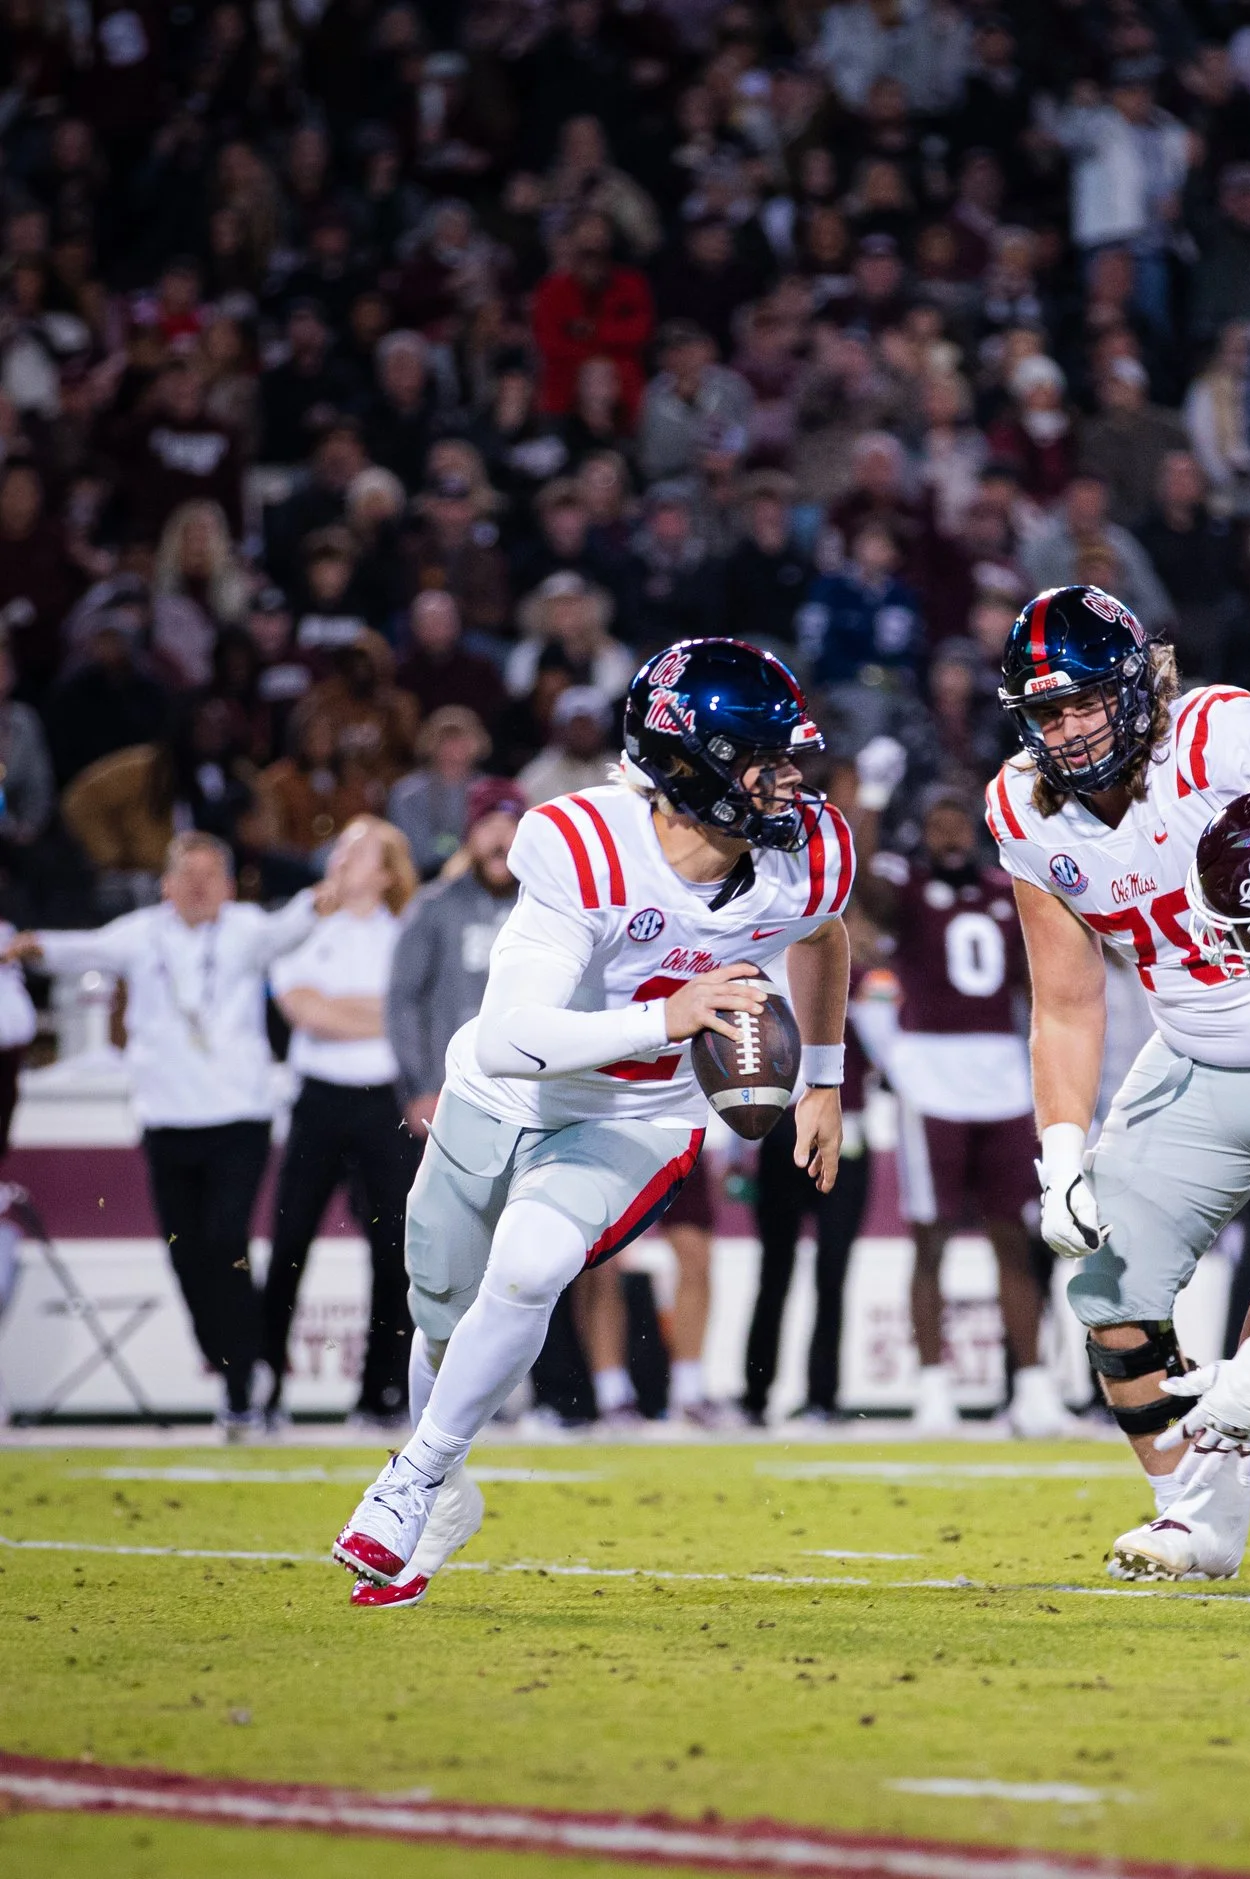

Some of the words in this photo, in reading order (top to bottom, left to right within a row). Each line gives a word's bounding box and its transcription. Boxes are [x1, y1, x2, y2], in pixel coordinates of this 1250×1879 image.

[1082, 593, 1121, 623] Ole
[649, 650, 692, 687] Ole
[1030, 677, 1058, 693] REBS
[1050, 855, 1079, 887] SEC
[1111, 878, 1131, 904] Ole
[1126, 872, 1157, 897] Miss
[629, 909, 664, 941] SEC
[661, 948, 688, 971] Ole
[685, 951, 721, 974] Miss
[945, 912, 1005, 997] 0
